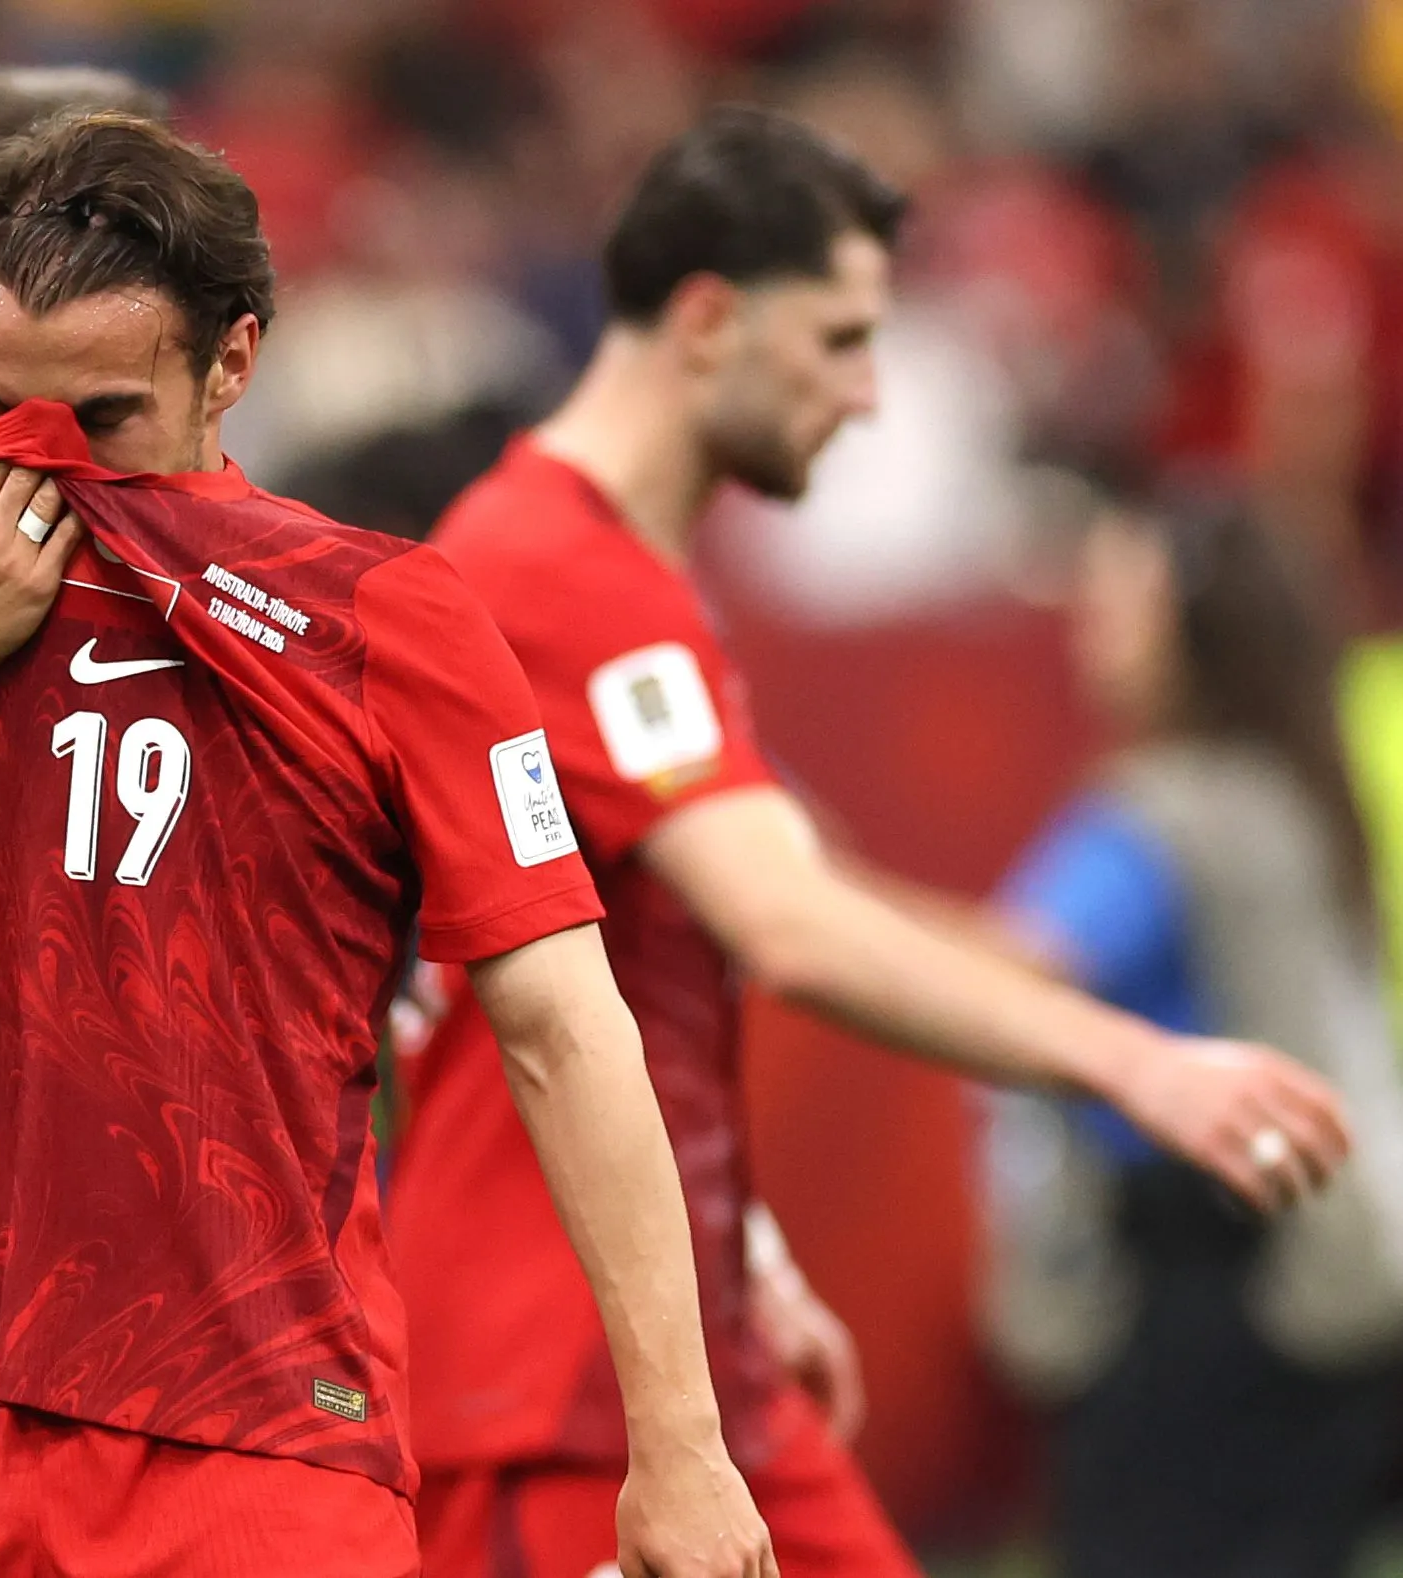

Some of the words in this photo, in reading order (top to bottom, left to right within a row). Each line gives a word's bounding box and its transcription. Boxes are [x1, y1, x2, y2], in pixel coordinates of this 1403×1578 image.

[201, 563, 311, 636] AVUSTRALYA-TÜRKİYE
[207, 596, 224, 619] 13
[217, 604, 264, 641] HAZİRAN
[258, 626, 285, 653] 2026
[51, 710, 191, 887] 19
